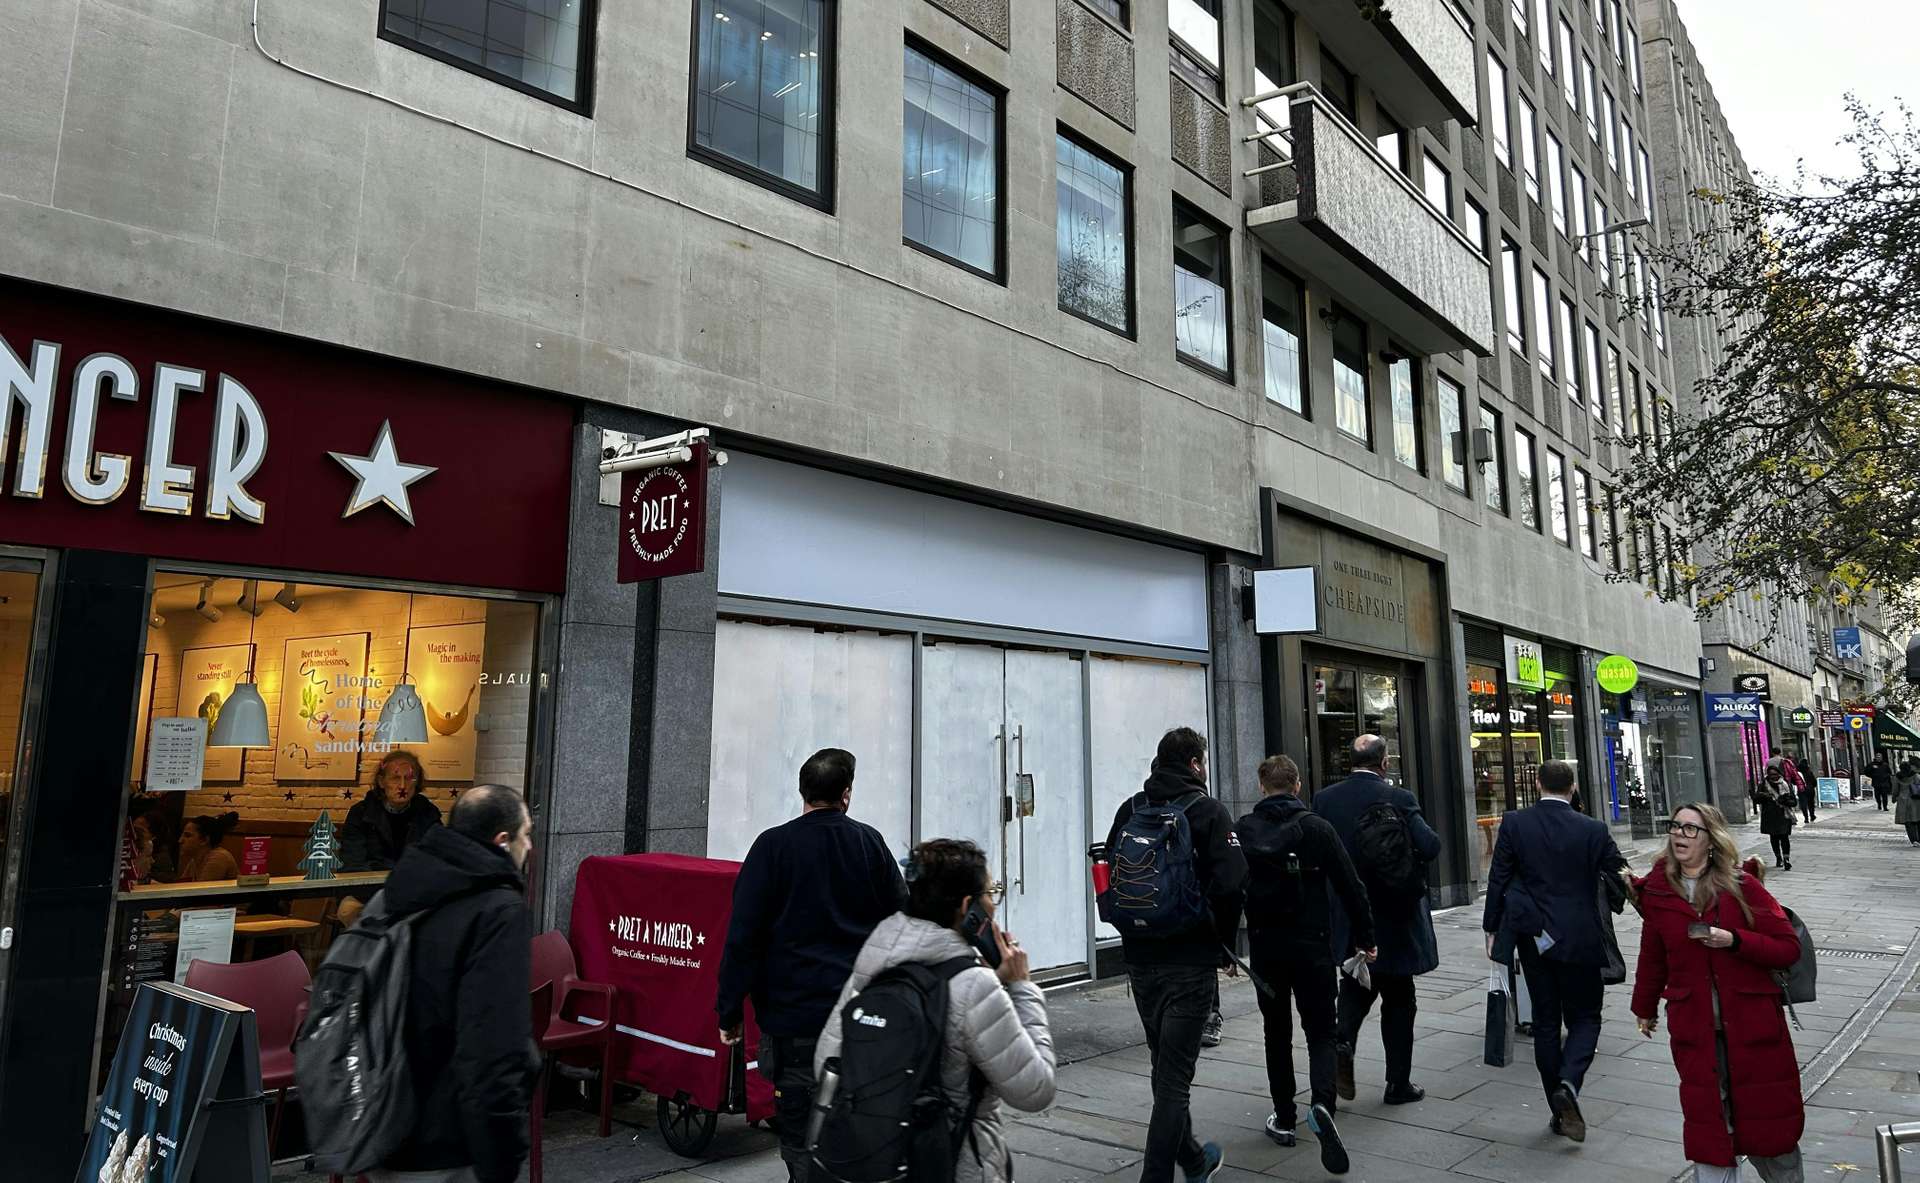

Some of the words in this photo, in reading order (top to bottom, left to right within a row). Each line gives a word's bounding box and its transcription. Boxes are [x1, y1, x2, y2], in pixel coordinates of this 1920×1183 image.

[0, 334, 268, 524] NGER
[632, 467, 661, 503] ORGANIC
[664, 466, 688, 493] COFFEE
[641, 494, 678, 534] PRET
[629, 527, 652, 560] FRESHLY
[653, 544, 674, 562] MADE
[673, 518, 688, 546] FOOD
[1333, 560, 1348, 574] ONE
[1350, 565, 1371, 580] THREE
[1325, 584, 1404, 624] CHEAPSIDE
[314, 649, 323, 658] the
[324, 648, 338, 658] cycle
[427, 642, 448, 654] Magic
[449, 642, 456, 652] in
[1836, 643, 1862, 658] HK
[208, 662, 223, 671] Never
[440, 653, 452, 663] the
[453, 652, 481, 664] making
[197, 672, 220, 681] standing
[221, 670, 232, 679] still
[336, 673, 383, 688] Home
[1600, 665, 1633, 679] wasabi
[336, 694, 352, 709] of
[357, 694, 382, 709] the
[1714, 704, 1758, 712] HALIFAX
[1472, 709, 1527, 724] flavur
[315, 738, 392, 753] sandwich
[308, 829, 332, 859] PRET
[617, 915, 641, 942] PRET
[643, 920, 650, 943] A
[653, 920, 693, 950] MANGER
[611, 946, 629, 957] Organic
[629, 949, 645, 960] Coffee
[651, 953, 669, 966] Freshly
[669, 956, 685, 967] Made
[686, 958, 701, 969] Food
[149, 1022, 187, 1052] Christmas
[143, 1051, 174, 1076] inside
[133, 1076, 154, 1100] every
[153, 1087, 169, 1107] cup
